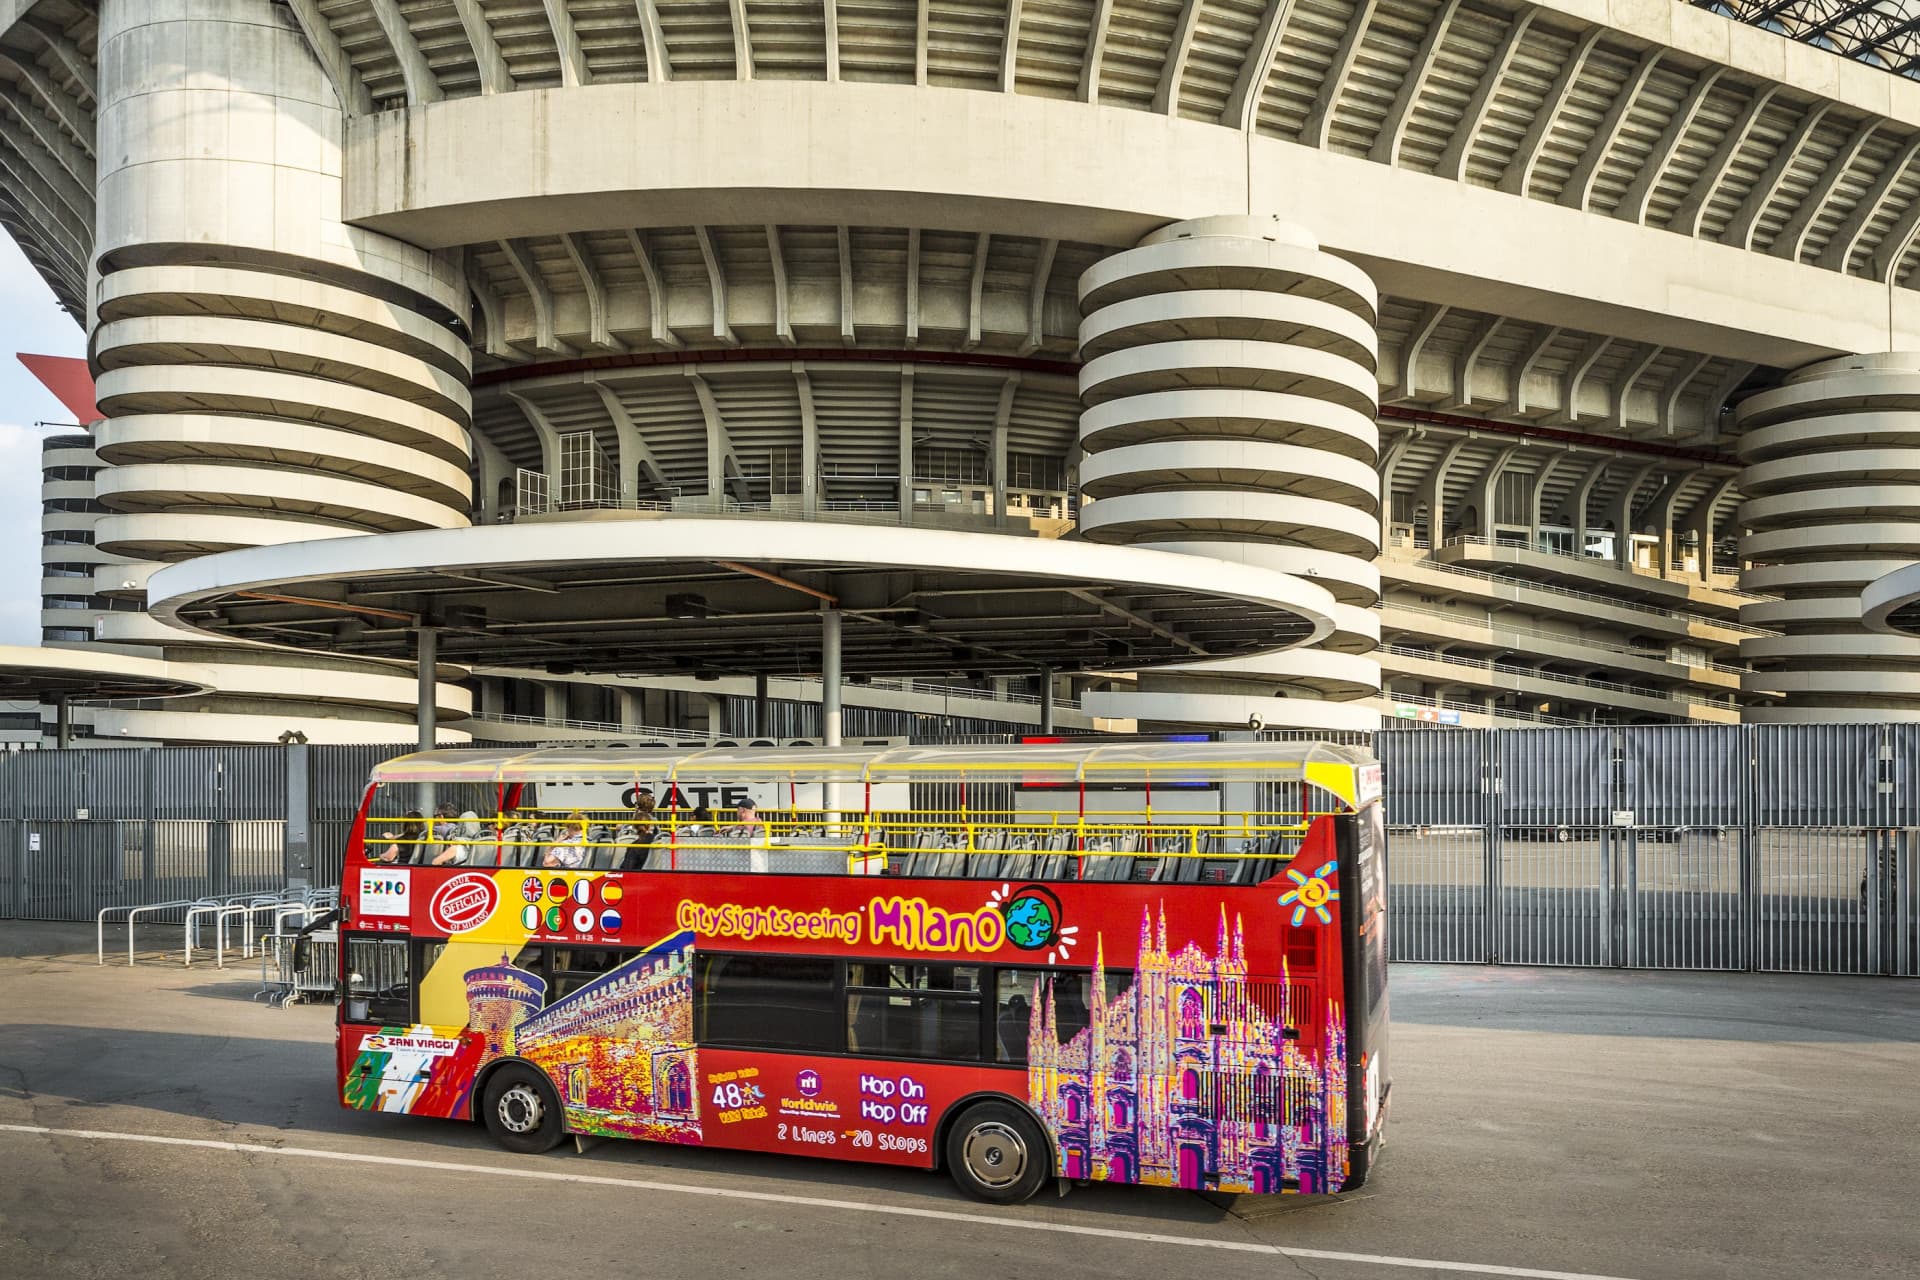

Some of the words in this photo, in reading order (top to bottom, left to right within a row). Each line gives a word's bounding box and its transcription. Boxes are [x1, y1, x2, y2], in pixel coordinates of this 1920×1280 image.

[363, 880, 406, 895] EXPO
[448, 876, 470, 889] TOUR
[443, 890, 487, 915] OFFICIAL
[462, 910, 489, 930] MILANO
[870, 896, 1006, 953] Milano
[388, 1037, 414, 1047] ZANI
[416, 1038, 454, 1050] VIAGGI
[712, 1083, 743, 1108] 48
[861, 1075, 895, 1097] Hop
[900, 1077, 924, 1099] On
[862, 1101, 896, 1123] Hop
[900, 1102, 928, 1124] Off
[777, 1123, 787, 1140] 2
[792, 1125, 837, 1144] Lines
[852, 1130, 873, 1147] 20
[878, 1133, 928, 1153] Stops
